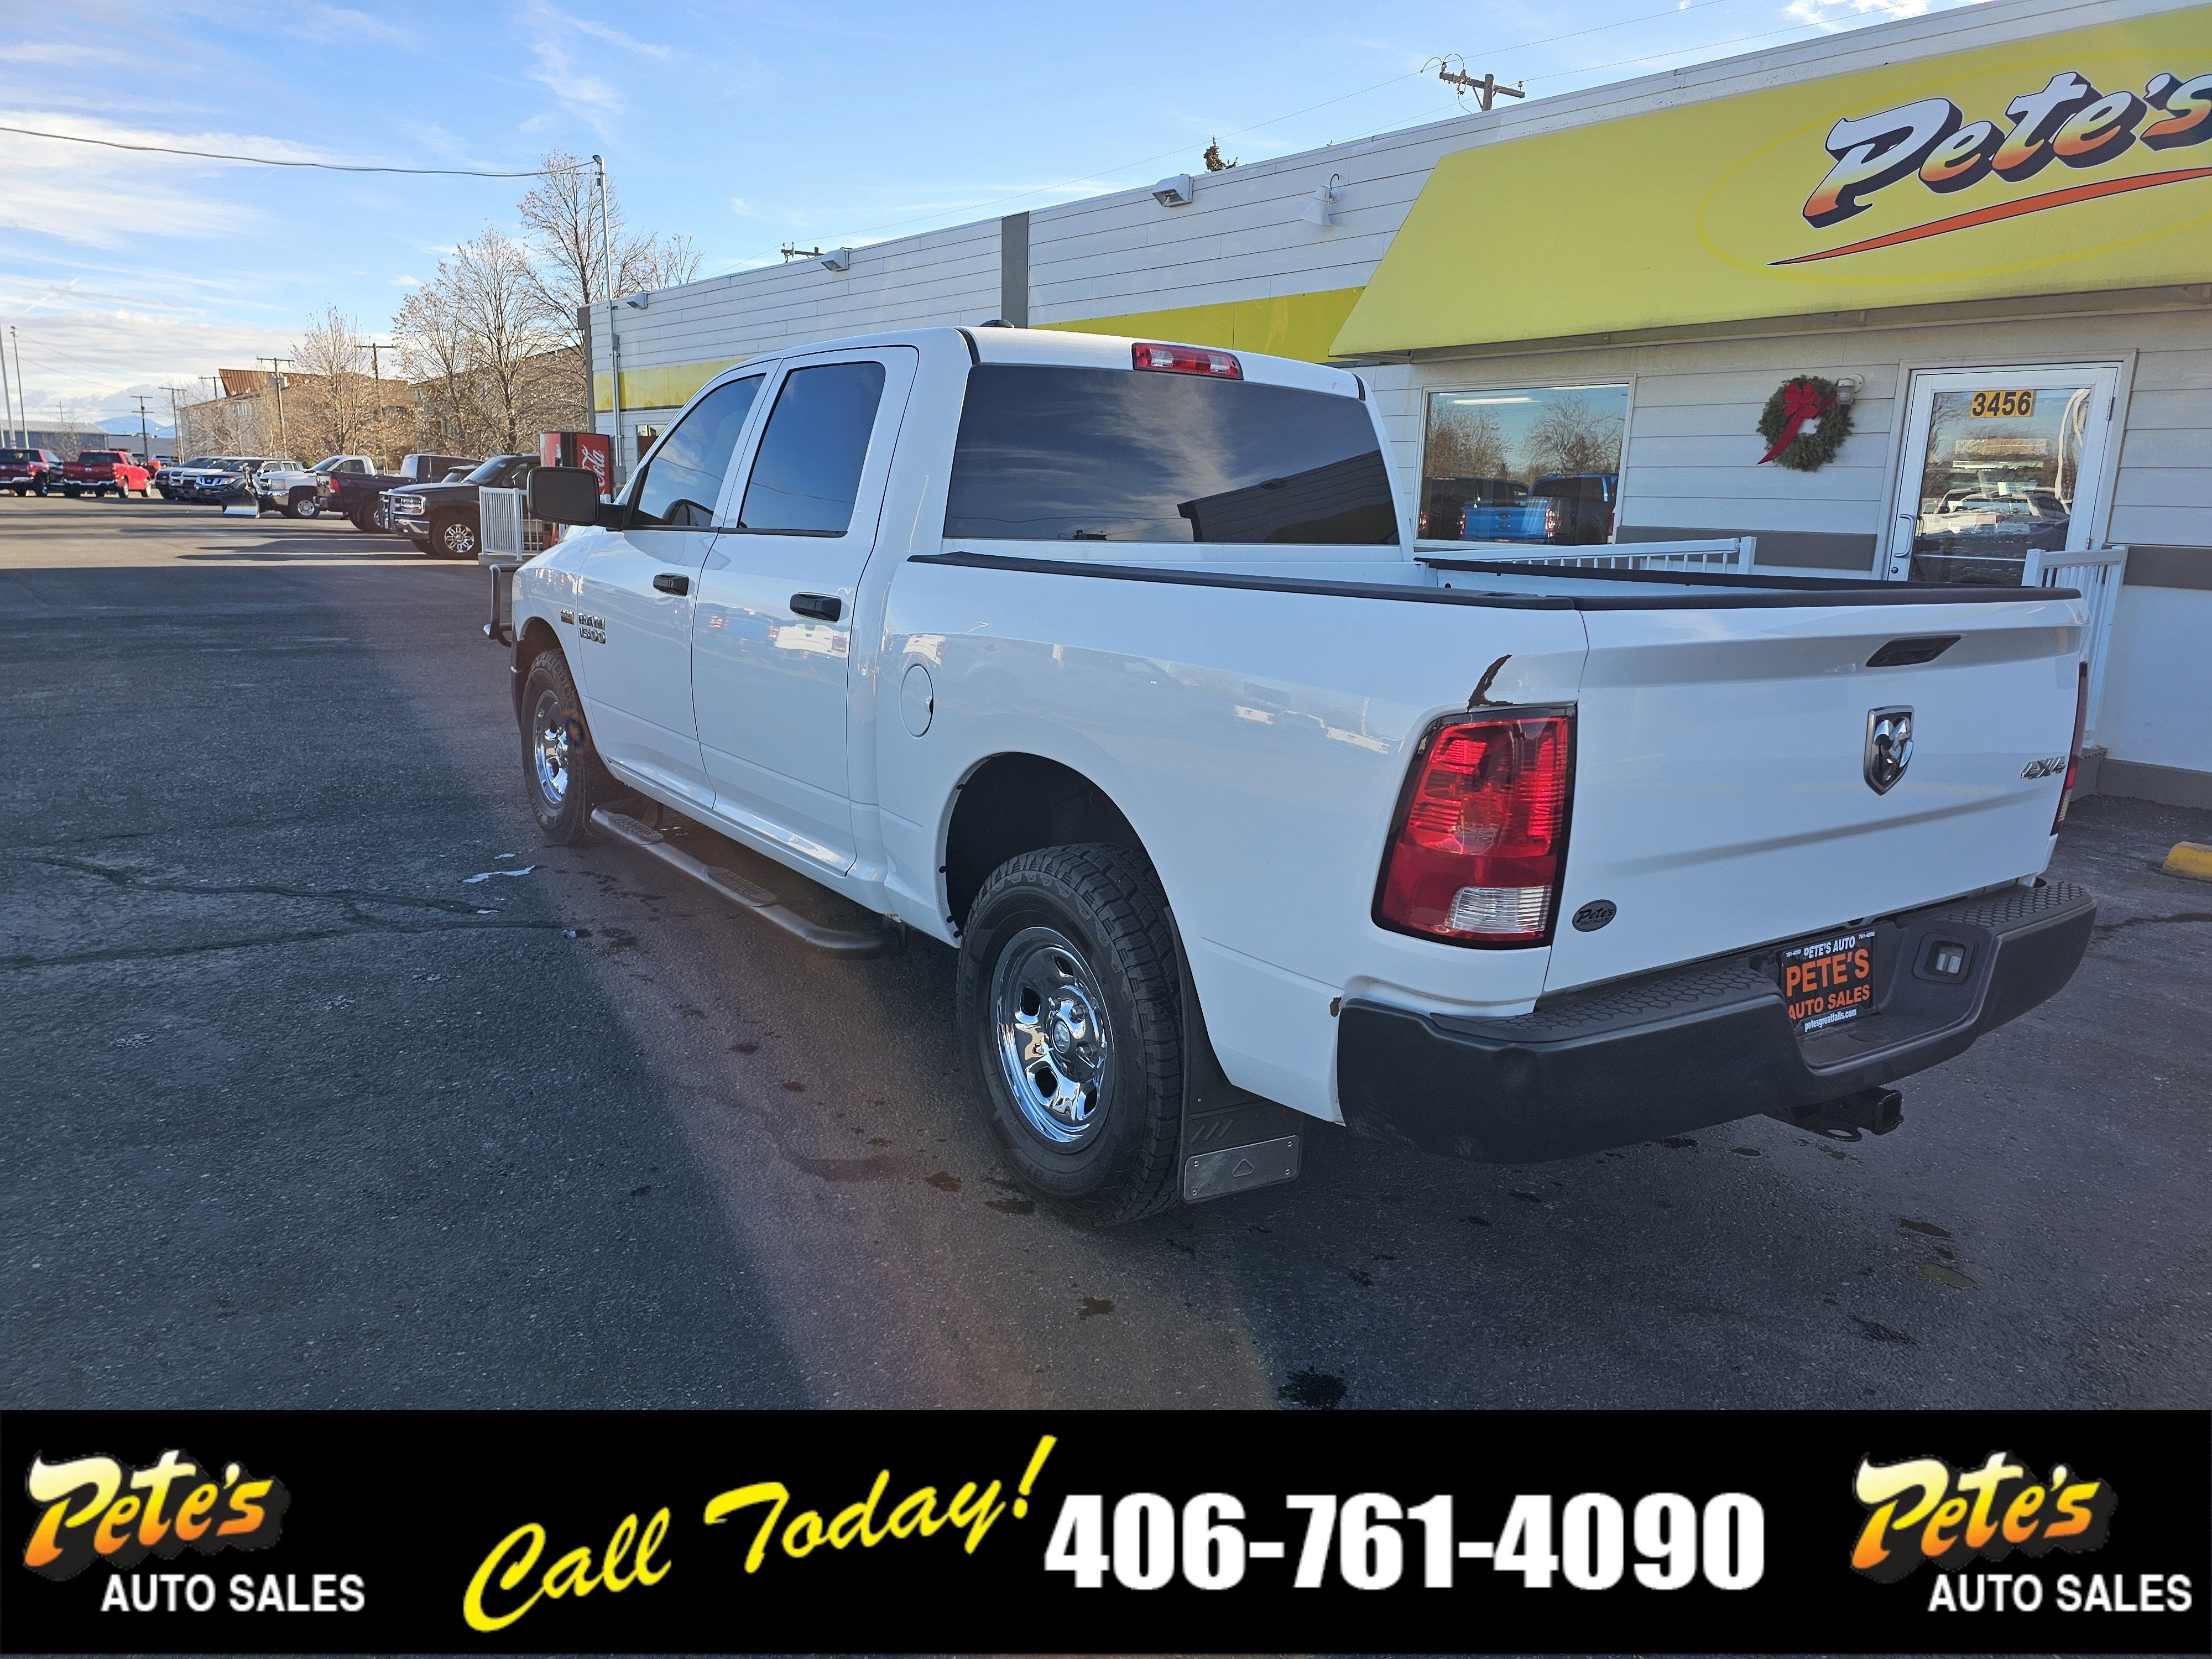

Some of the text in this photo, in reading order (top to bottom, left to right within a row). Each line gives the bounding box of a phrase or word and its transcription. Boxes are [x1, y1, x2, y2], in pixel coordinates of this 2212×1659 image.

[1802, 71, 2212, 229] Pete's
[1972, 390, 2032, 417] 3456
[578, 612, 606, 630] RAM
[579, 626, 606, 644] 1500
[1576, 907, 1614, 924] Pete's
[1803, 941, 1831, 959] PETE'S
[1833, 936, 1855, 953] AUTO
[1786, 948, 1870, 997] PETE'S
[1788, 984, 1870, 1020] AUTO SALES
[1804, 1008, 1857, 1033] petesgreatfalls.com
